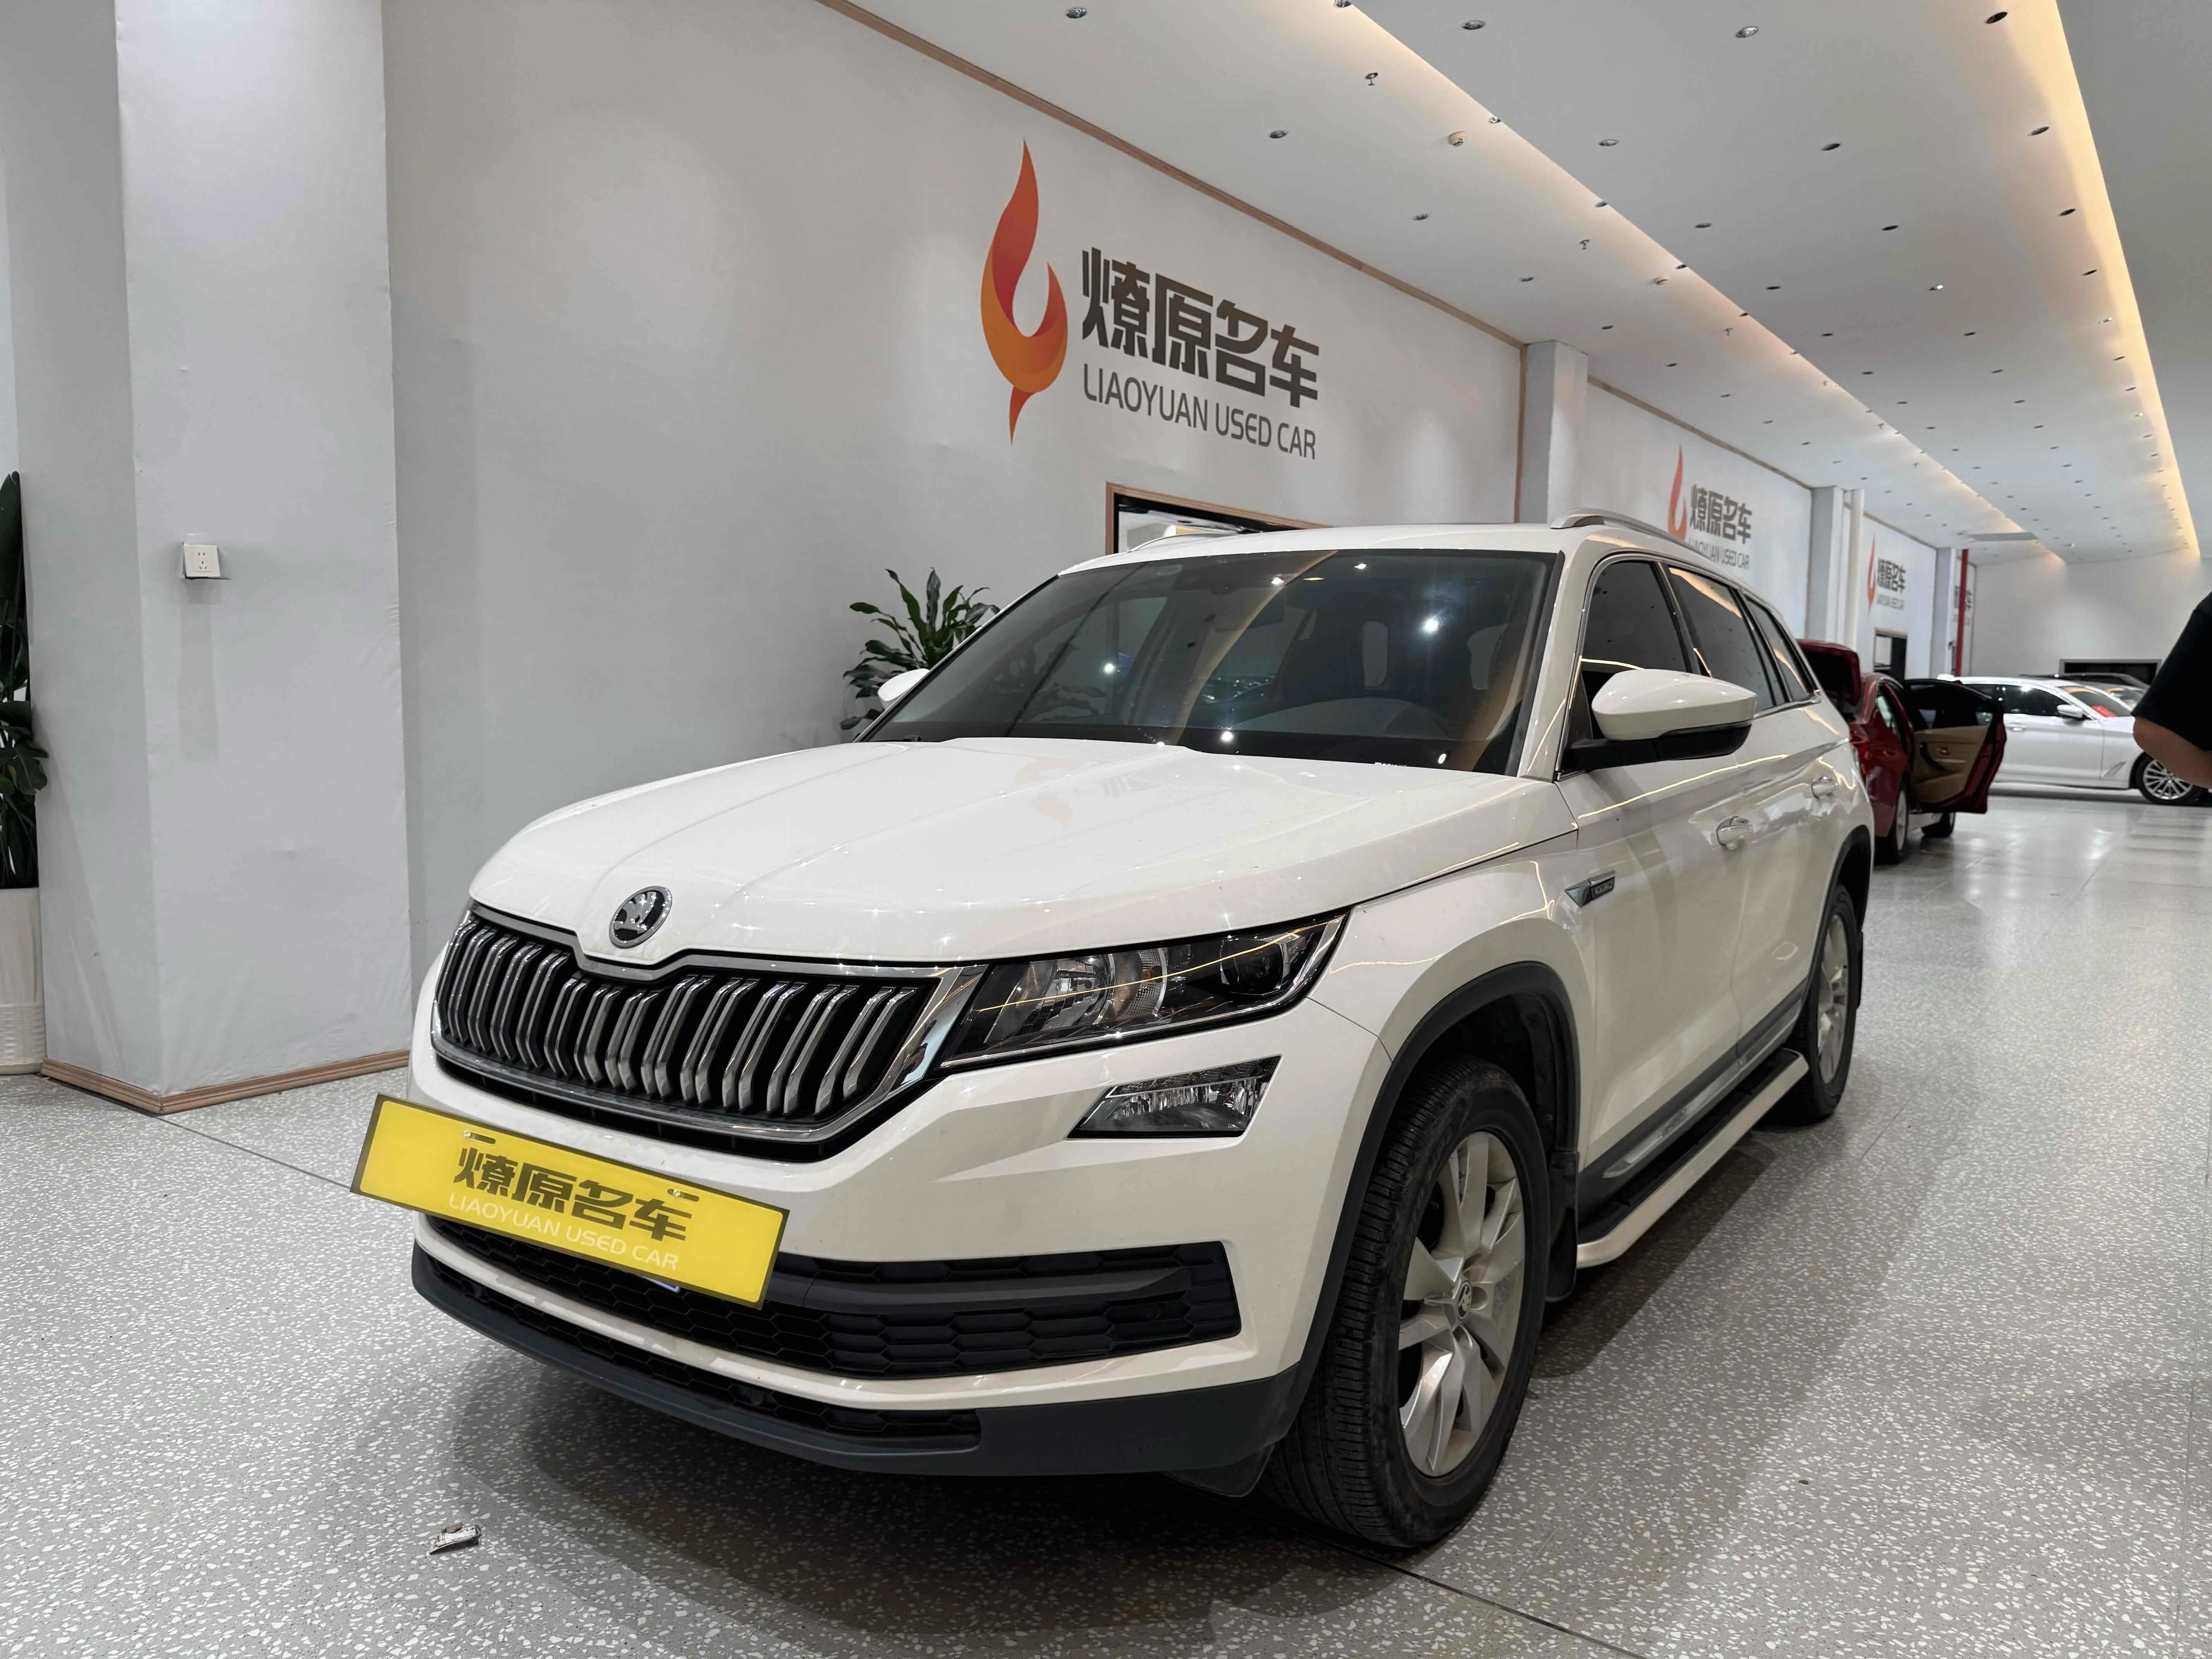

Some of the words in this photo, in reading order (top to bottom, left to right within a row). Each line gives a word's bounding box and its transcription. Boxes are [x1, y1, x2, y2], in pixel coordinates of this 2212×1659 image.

[1082, 247, 1319, 408] 燎原名车
[1084, 363, 1208, 431] LIAOYUAN
[1215, 402, 1271, 448] USED
[1277, 422, 1316, 460] CAR
[1690, 484, 1752, 544] 燎原名车
[449, 1193, 560, 1237] LIAOYUAN
[566, 1225, 627, 1255] USED
[632, 1245, 678, 1271] CAR
[453, 1147, 692, 1241] 燎原名车
